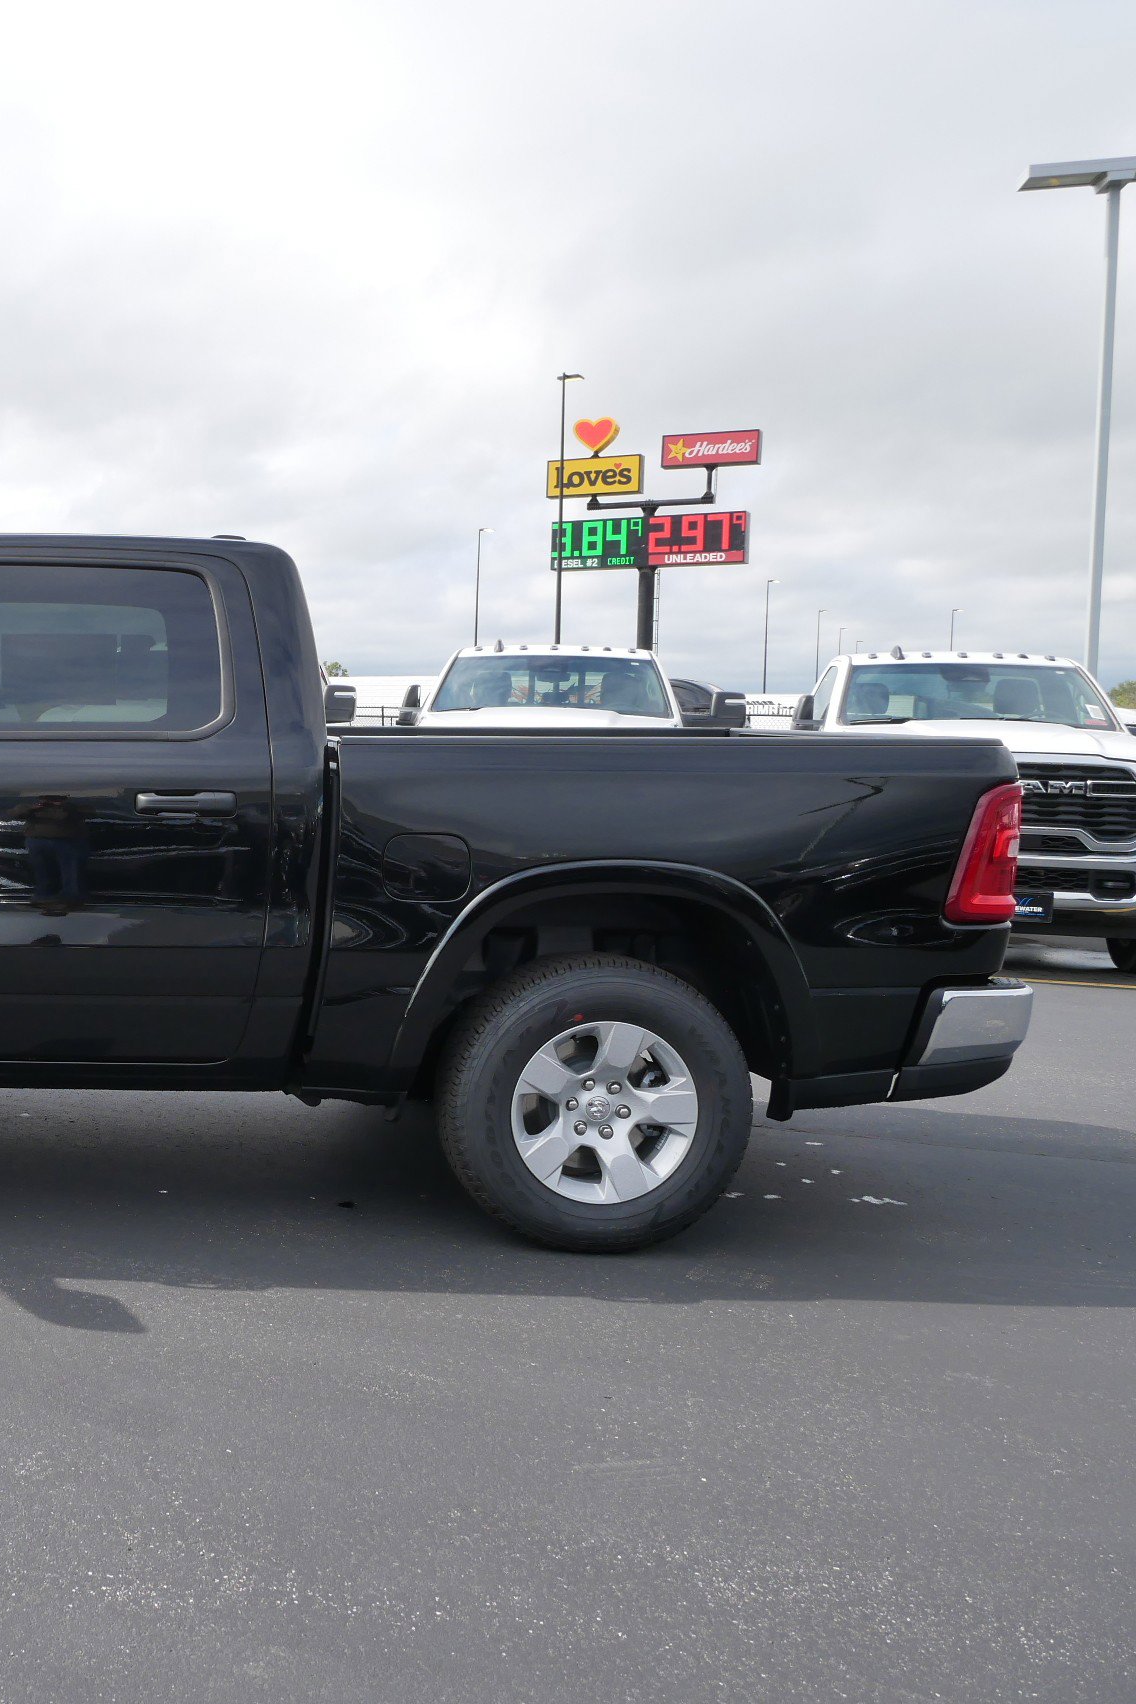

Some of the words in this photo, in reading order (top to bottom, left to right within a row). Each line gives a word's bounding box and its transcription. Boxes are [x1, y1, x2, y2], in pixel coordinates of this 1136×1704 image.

[685, 440, 752, 457] Hardee's
[607, 557, 634, 565] CREDIT
[665, 552, 726, 563] UNLEADED
[554, 559, 584, 568] ESEL
[586, 559, 598, 567] #2
[1018, 779, 1085, 794] AM
